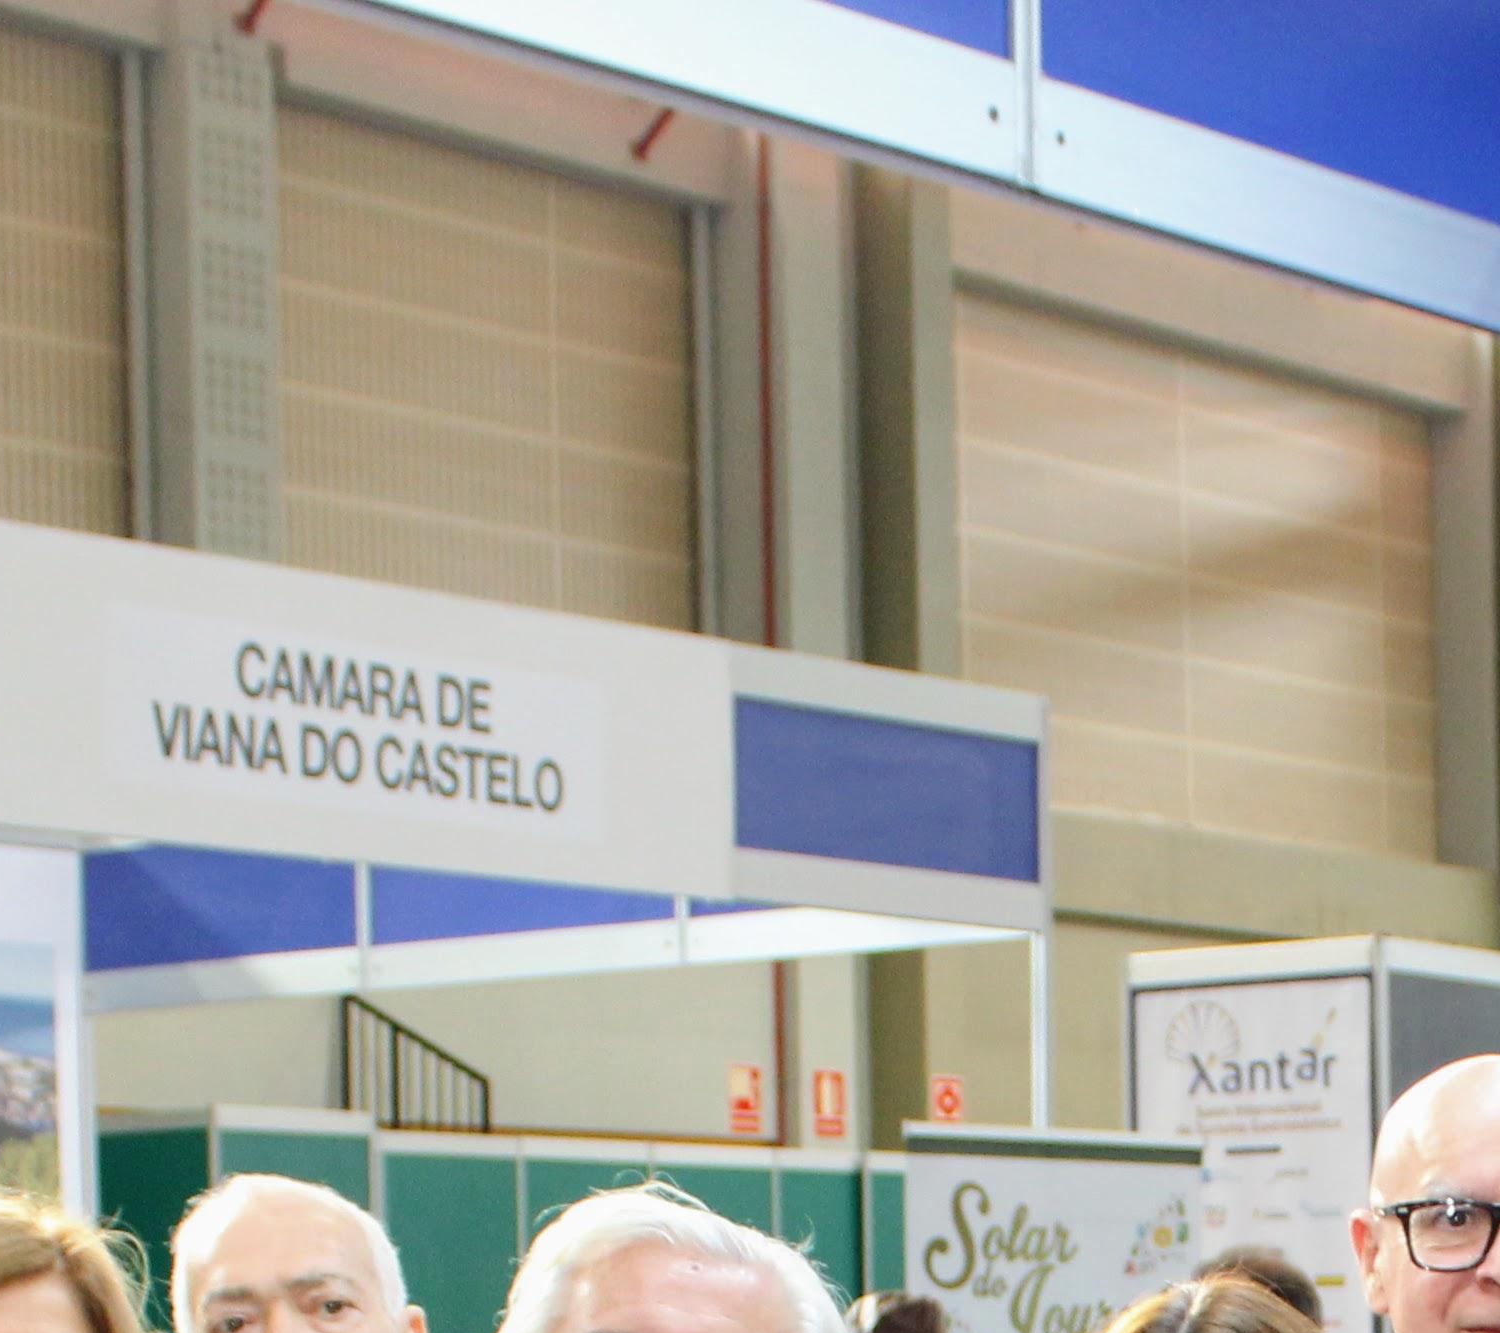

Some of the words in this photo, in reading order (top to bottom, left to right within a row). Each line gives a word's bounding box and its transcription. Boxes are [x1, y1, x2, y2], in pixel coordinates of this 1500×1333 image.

[236, 641, 426, 725] CAMARA
[437, 674, 493, 734] DE
[152, 700, 288, 775] VIANA
[301, 723, 363, 783] DO
[376, 734, 563, 812] CASTELO
[923, 1180, 1078, 1290] Solar
[972, 1263, 1008, 1297] do
